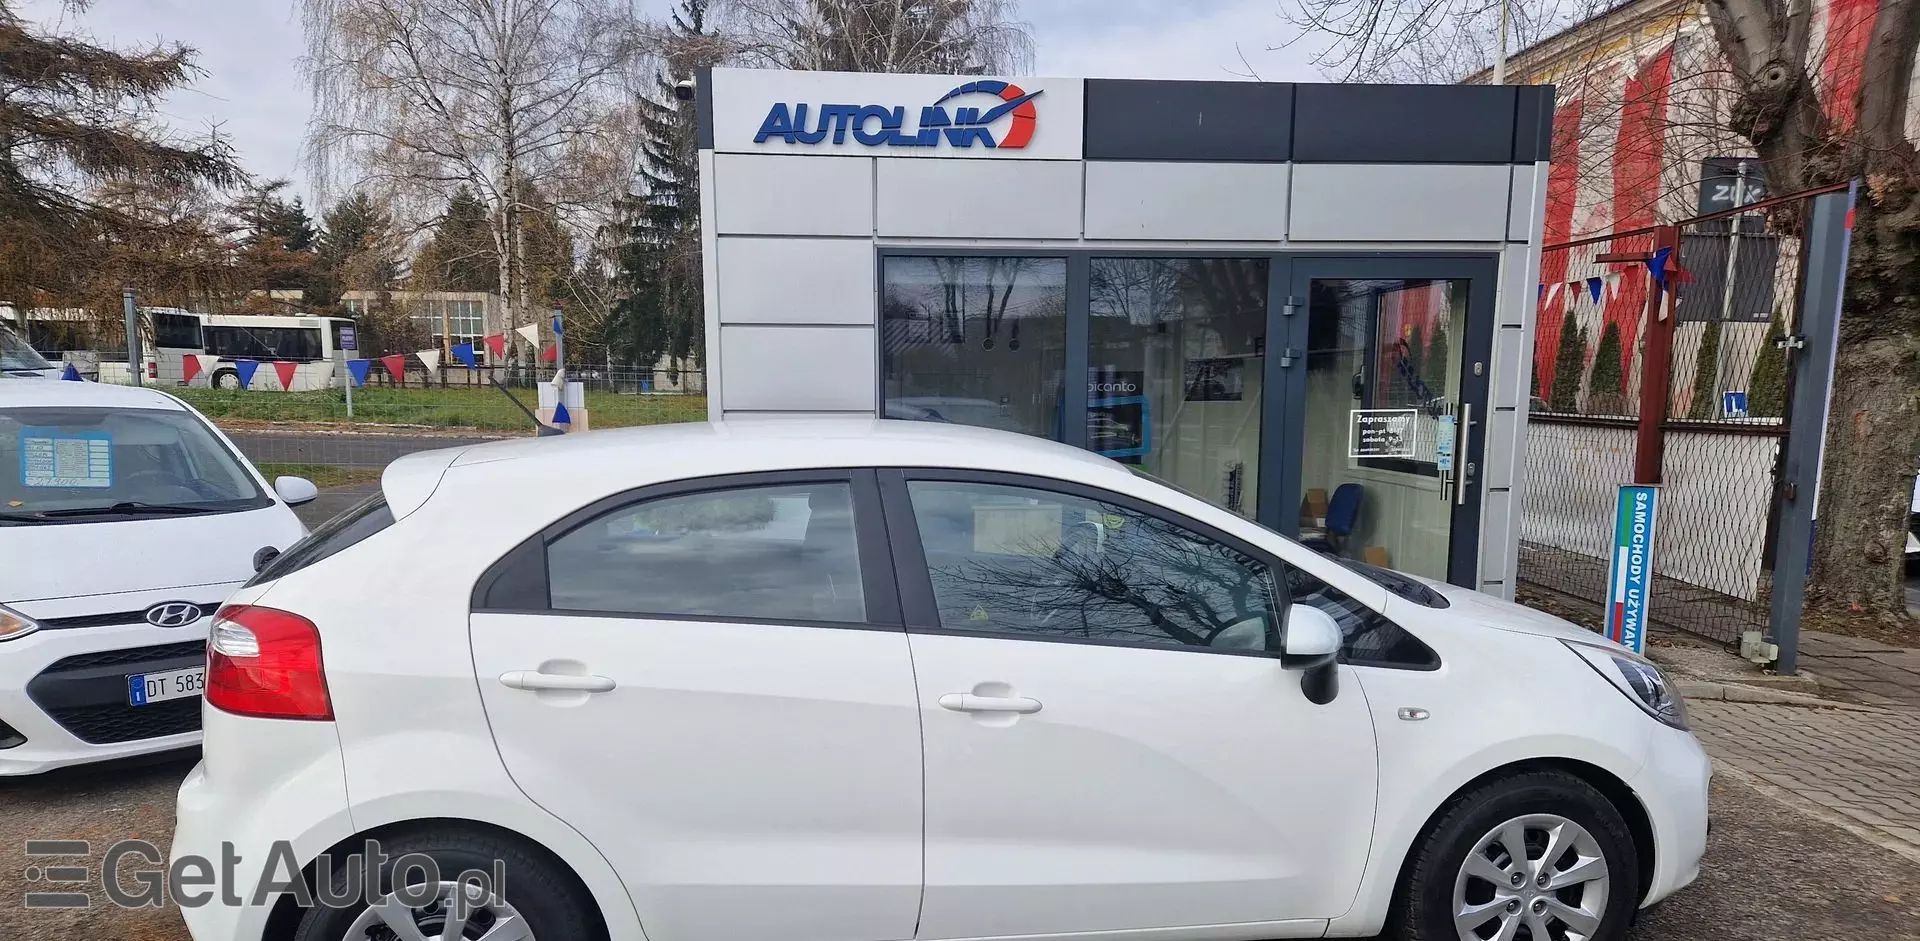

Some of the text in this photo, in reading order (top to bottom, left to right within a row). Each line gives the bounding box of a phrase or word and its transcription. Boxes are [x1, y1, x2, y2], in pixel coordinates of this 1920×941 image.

[753, 98, 1000, 148] AUTOLINK
[1357, 414, 1411, 425] Zapraszamy
[1629, 491, 1647, 586] SAMOCHODY
[147, 679, 166, 698] DT
[176, 673, 204, 692] 583
